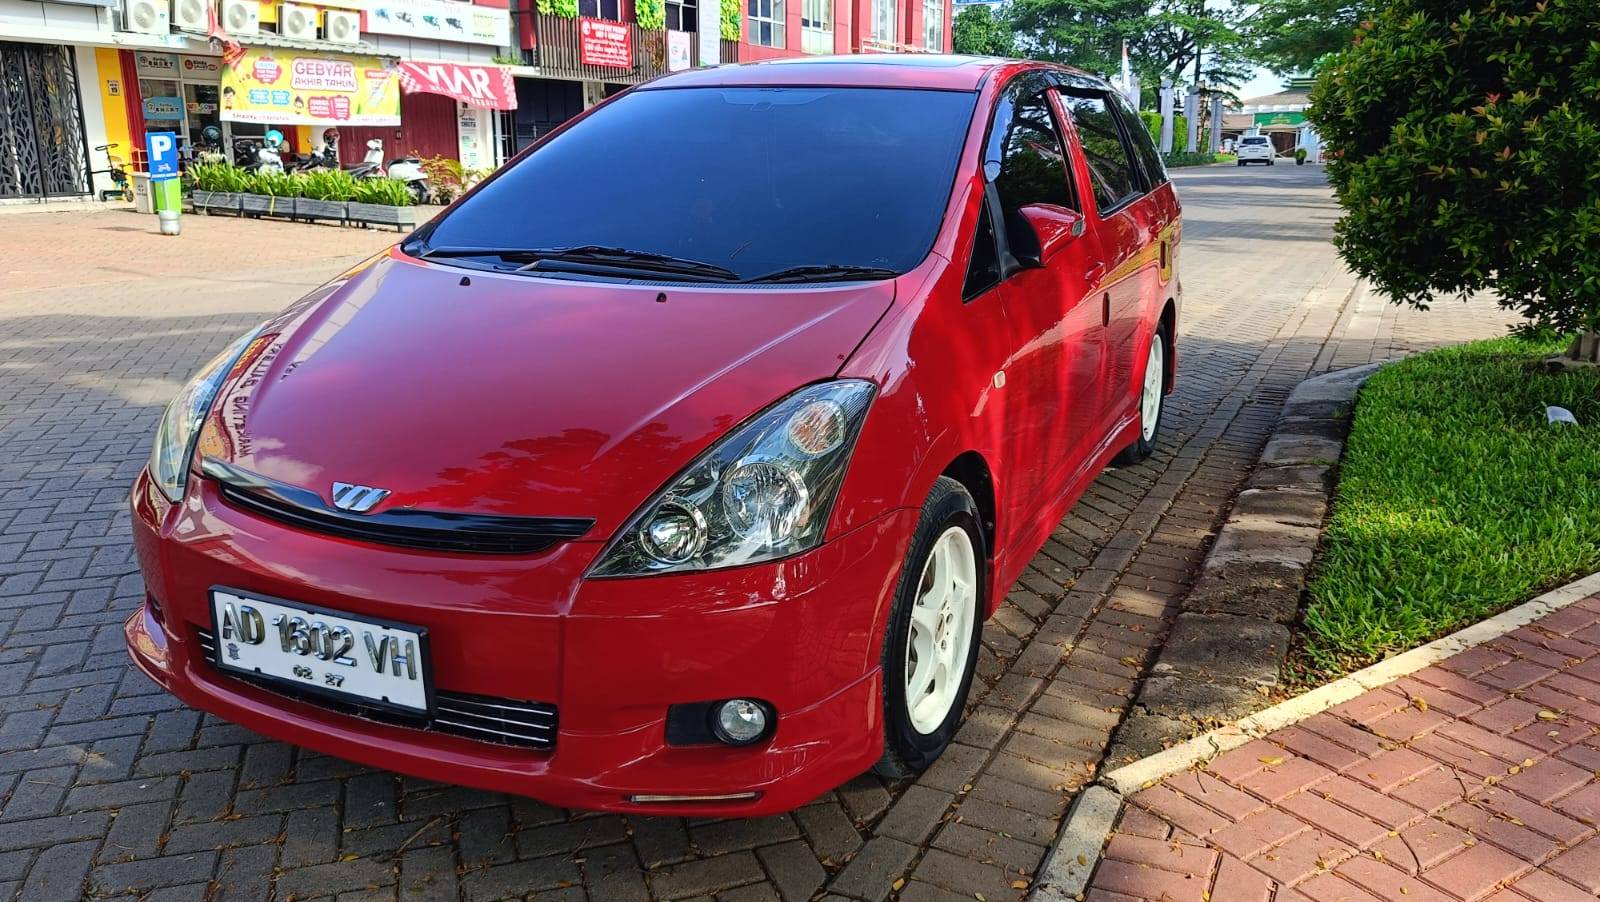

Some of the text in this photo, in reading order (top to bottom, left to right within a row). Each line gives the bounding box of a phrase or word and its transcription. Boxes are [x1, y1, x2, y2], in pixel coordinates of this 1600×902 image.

[294, 62, 352, 77] GEBYAR
[294, 77, 355, 88] AKHIR TAHUN
[151, 135, 171, 161] P
[222, 602, 417, 680] AD 1602 VH
[293, 664, 345, 688] 02 27
